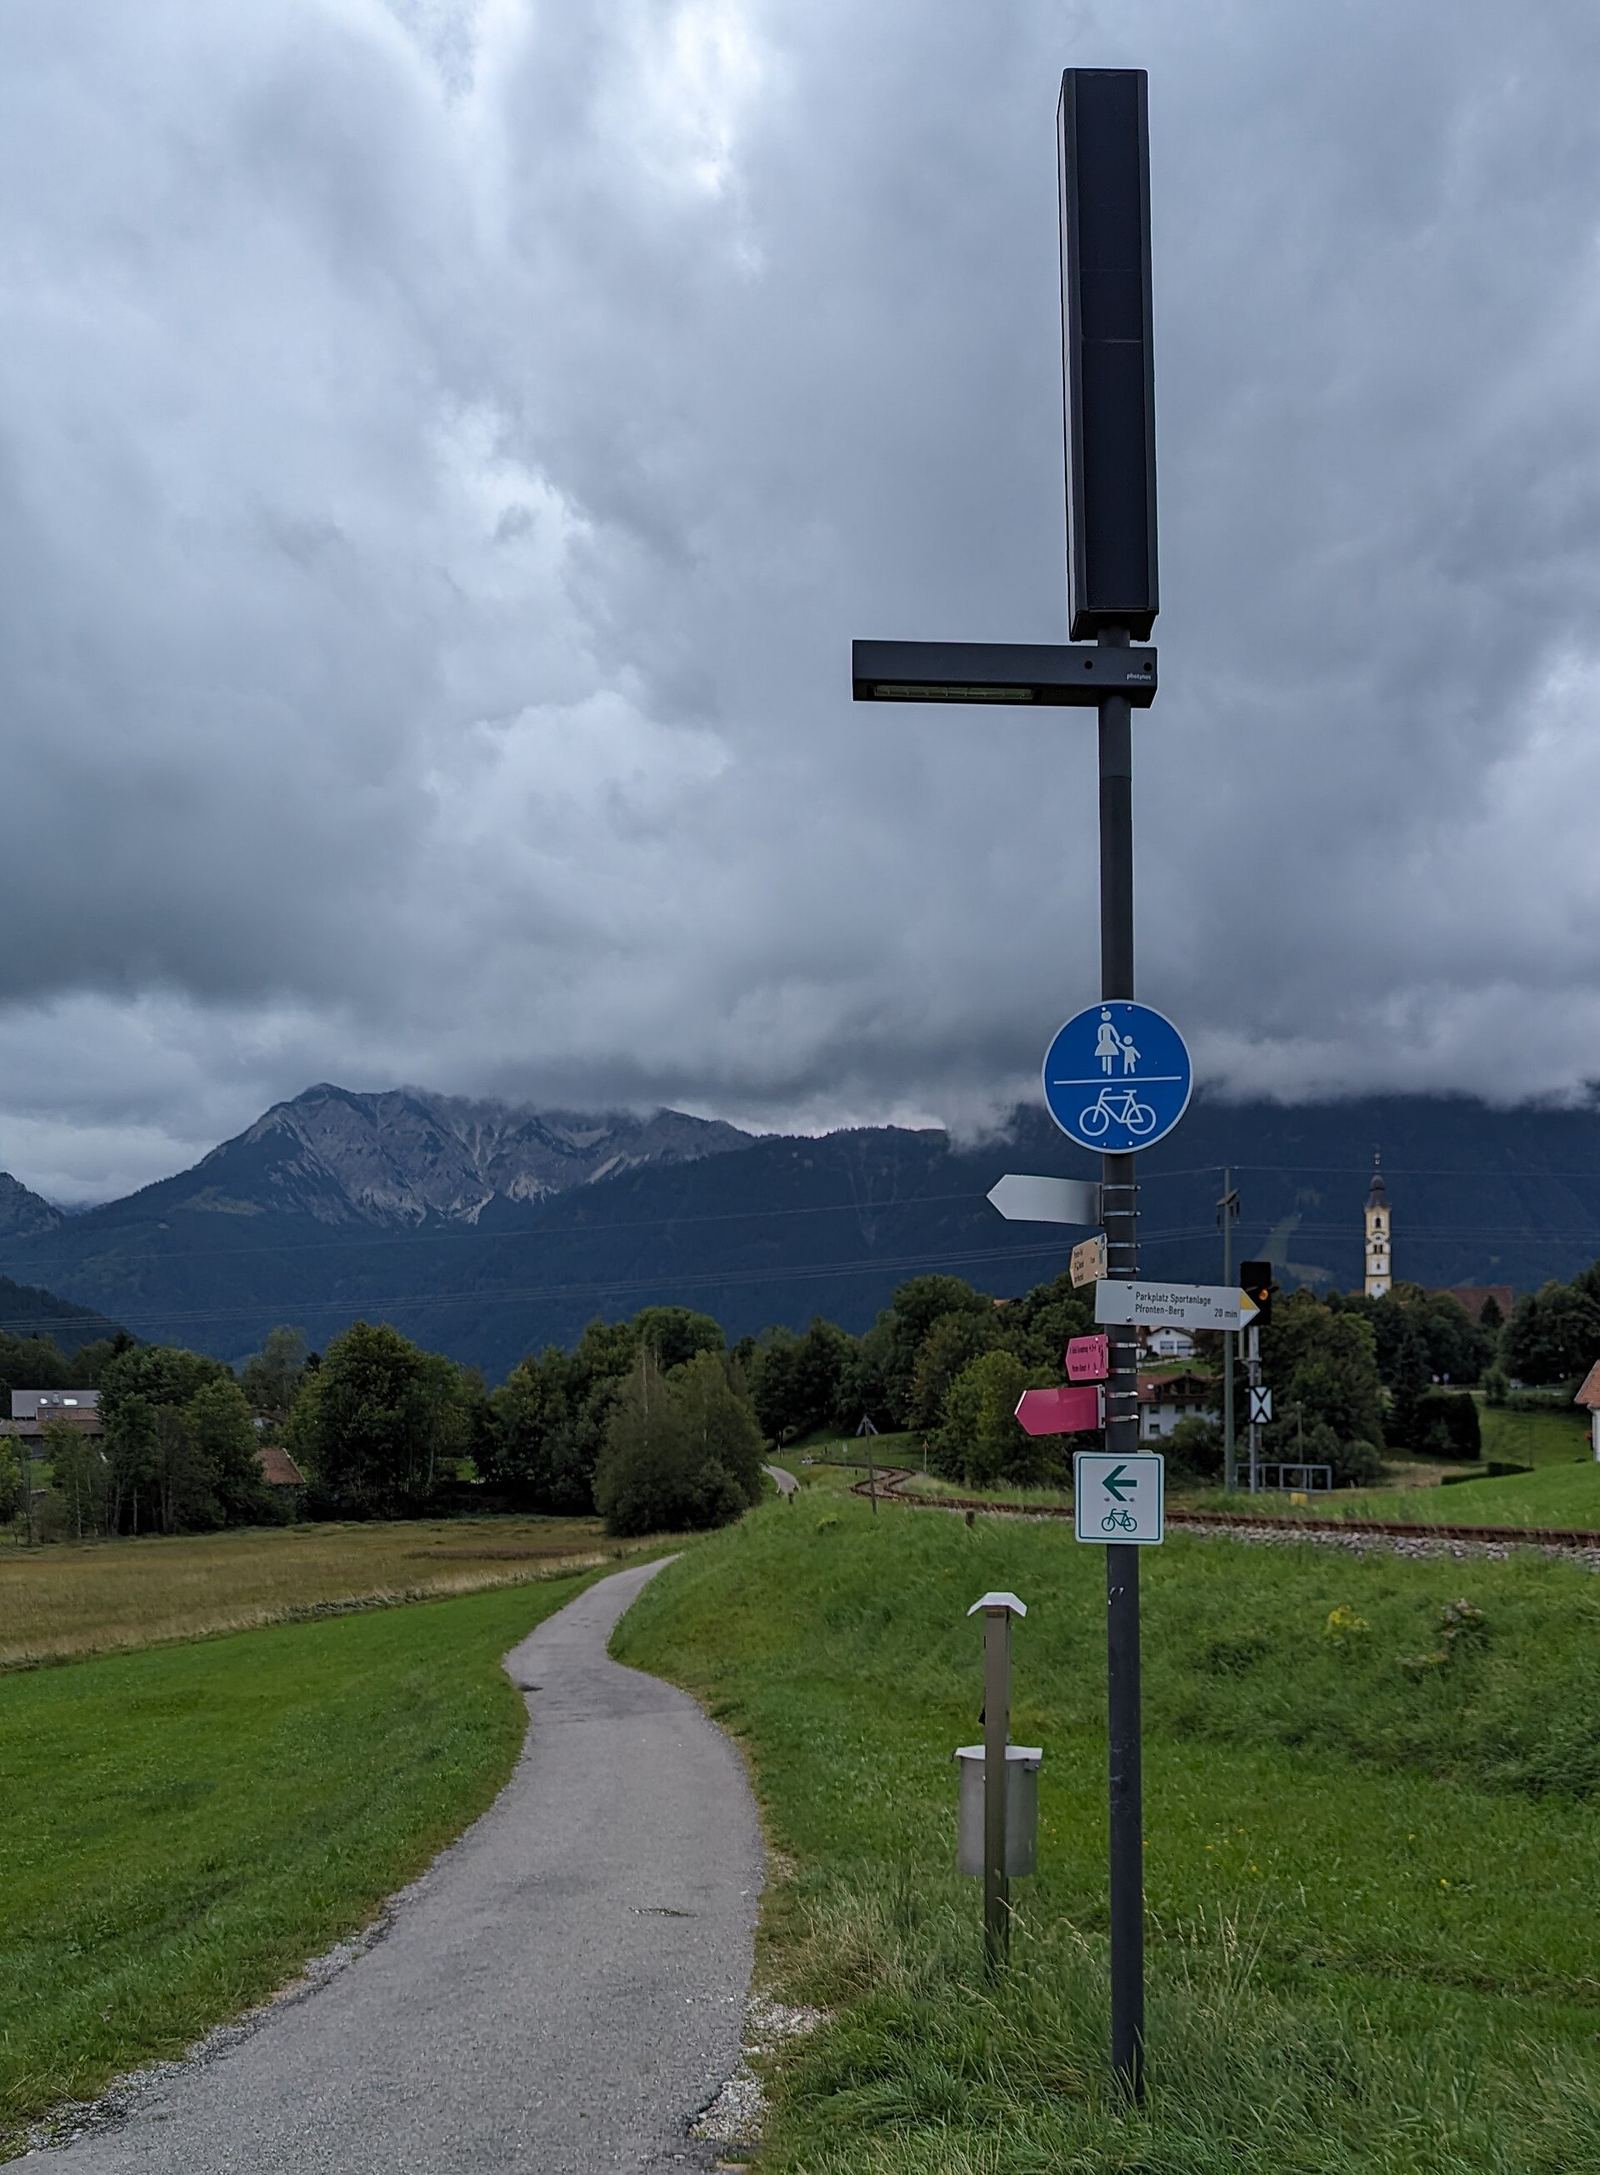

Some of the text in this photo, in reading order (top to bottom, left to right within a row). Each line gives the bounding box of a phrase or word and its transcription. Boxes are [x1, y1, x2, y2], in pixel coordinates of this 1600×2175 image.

[1135, 1291, 1212, 1307] Parkplatz Sportanlage
[1135, 1304, 1185, 1317] Pfronten-Berg
[1214, 1308, 1238, 1318] 20 min
